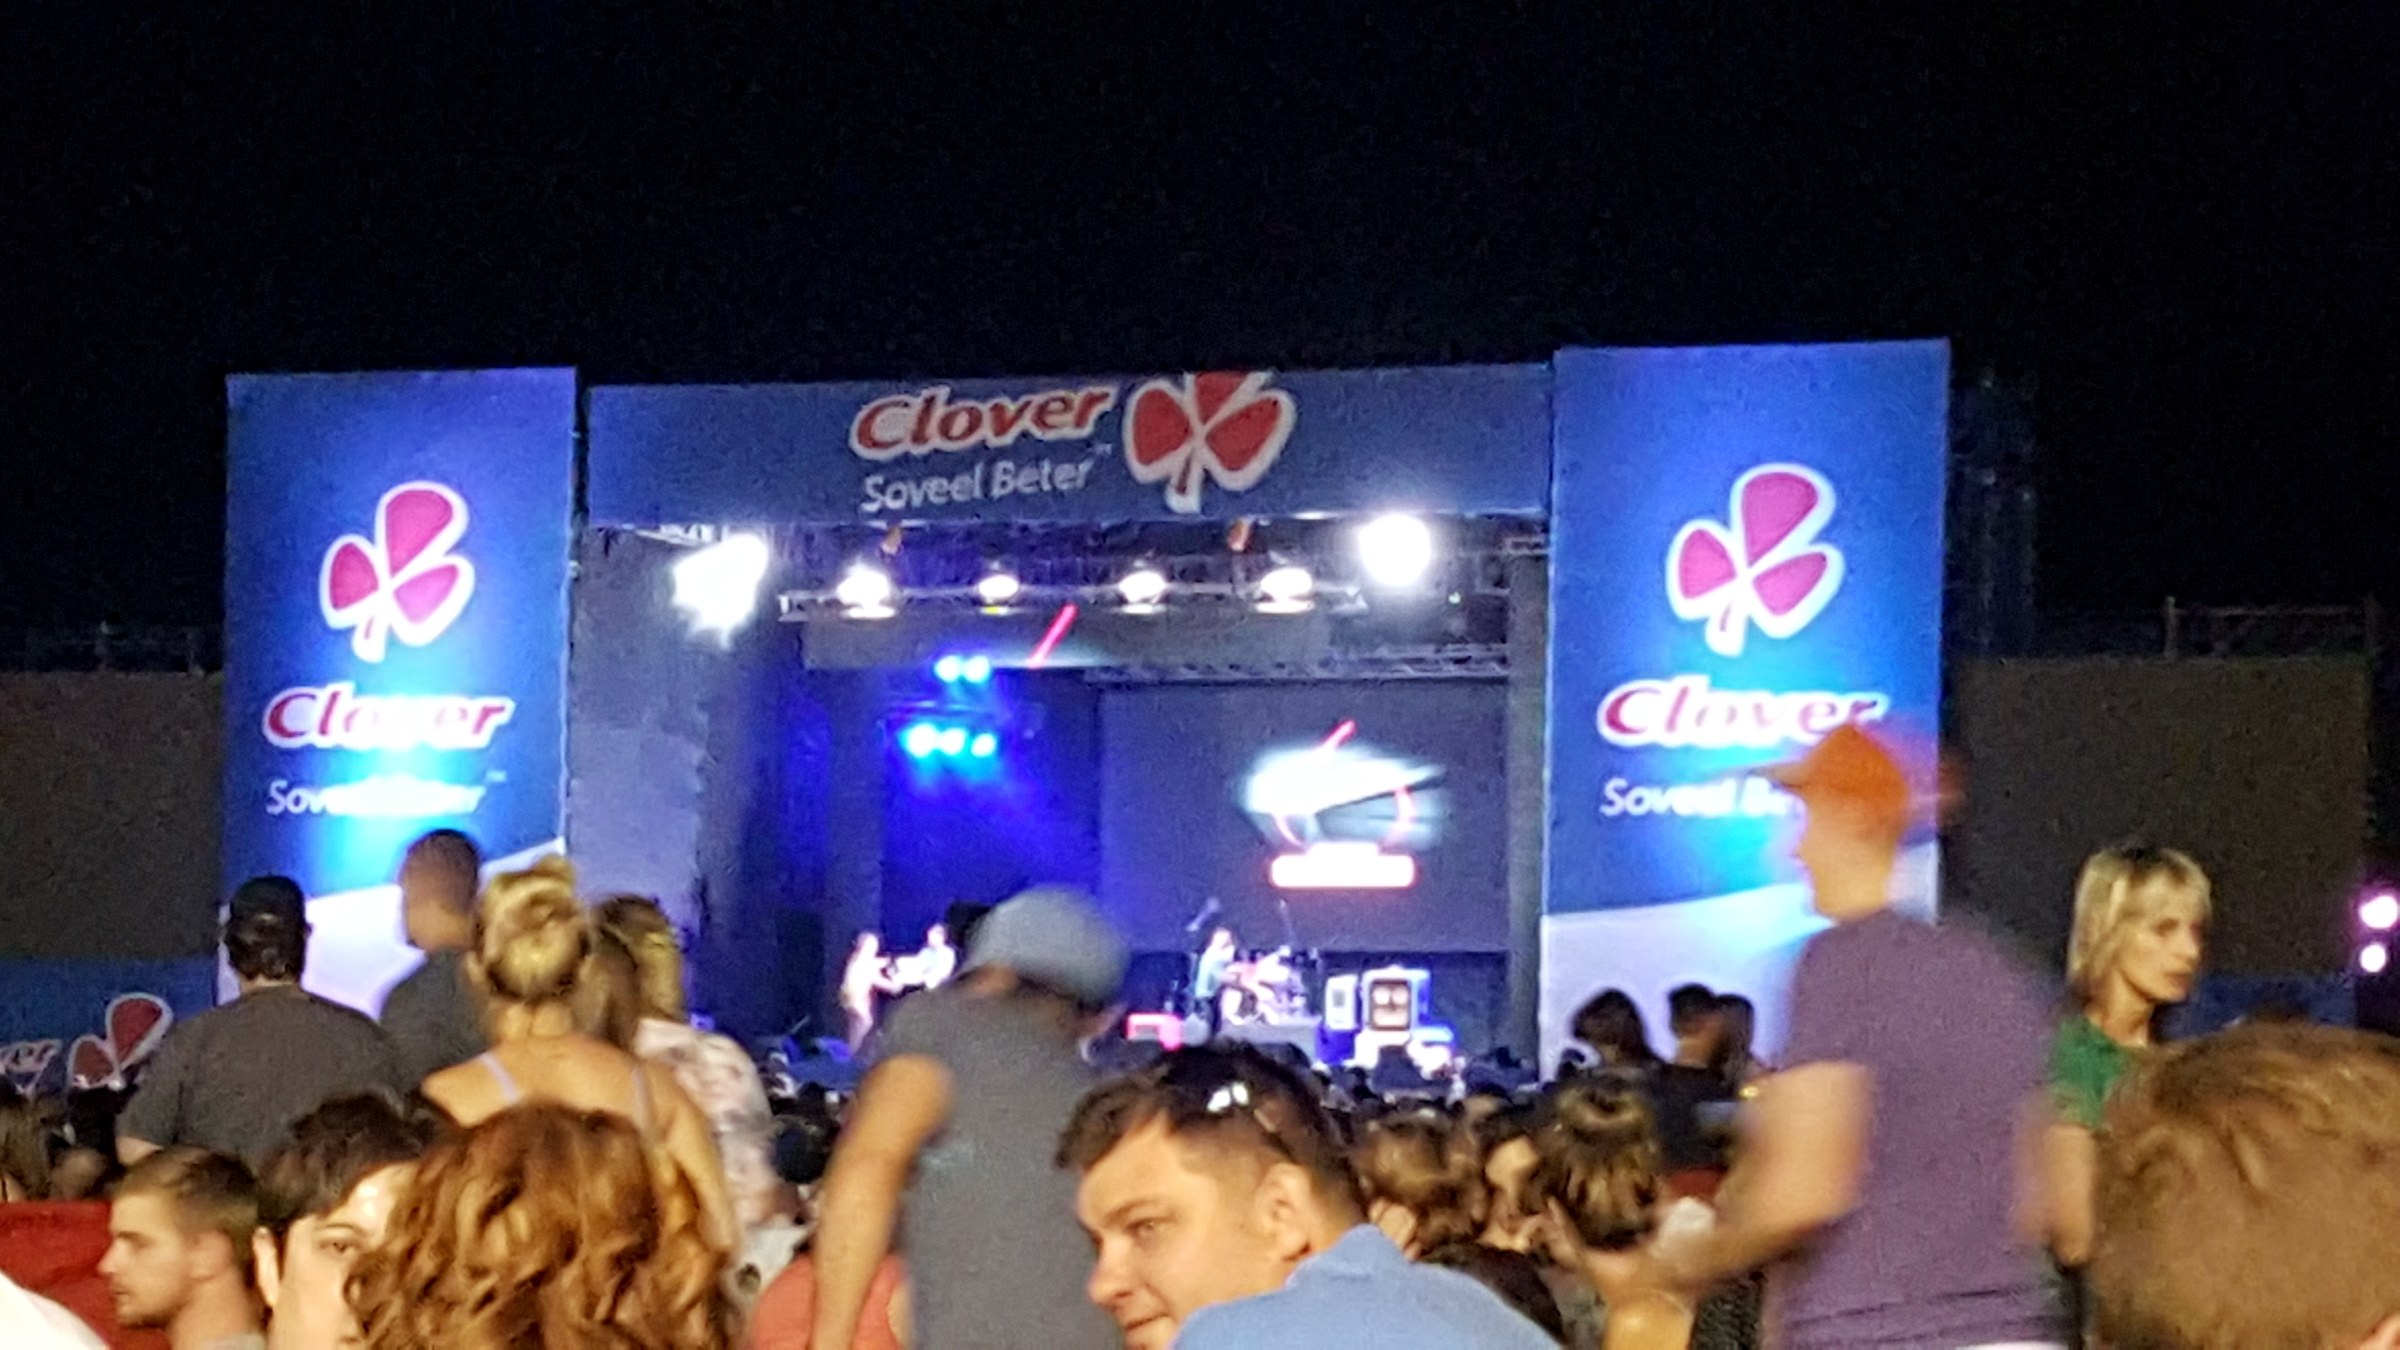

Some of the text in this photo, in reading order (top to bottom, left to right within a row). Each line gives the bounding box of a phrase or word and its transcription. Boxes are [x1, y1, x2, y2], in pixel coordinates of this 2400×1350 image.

[851, 386, 1117, 459] Clover
[860, 458, 1093, 511] Soveel Beter
[263, 682, 514, 748] Cloer
[1600, 777, 1737, 816] Sovl
